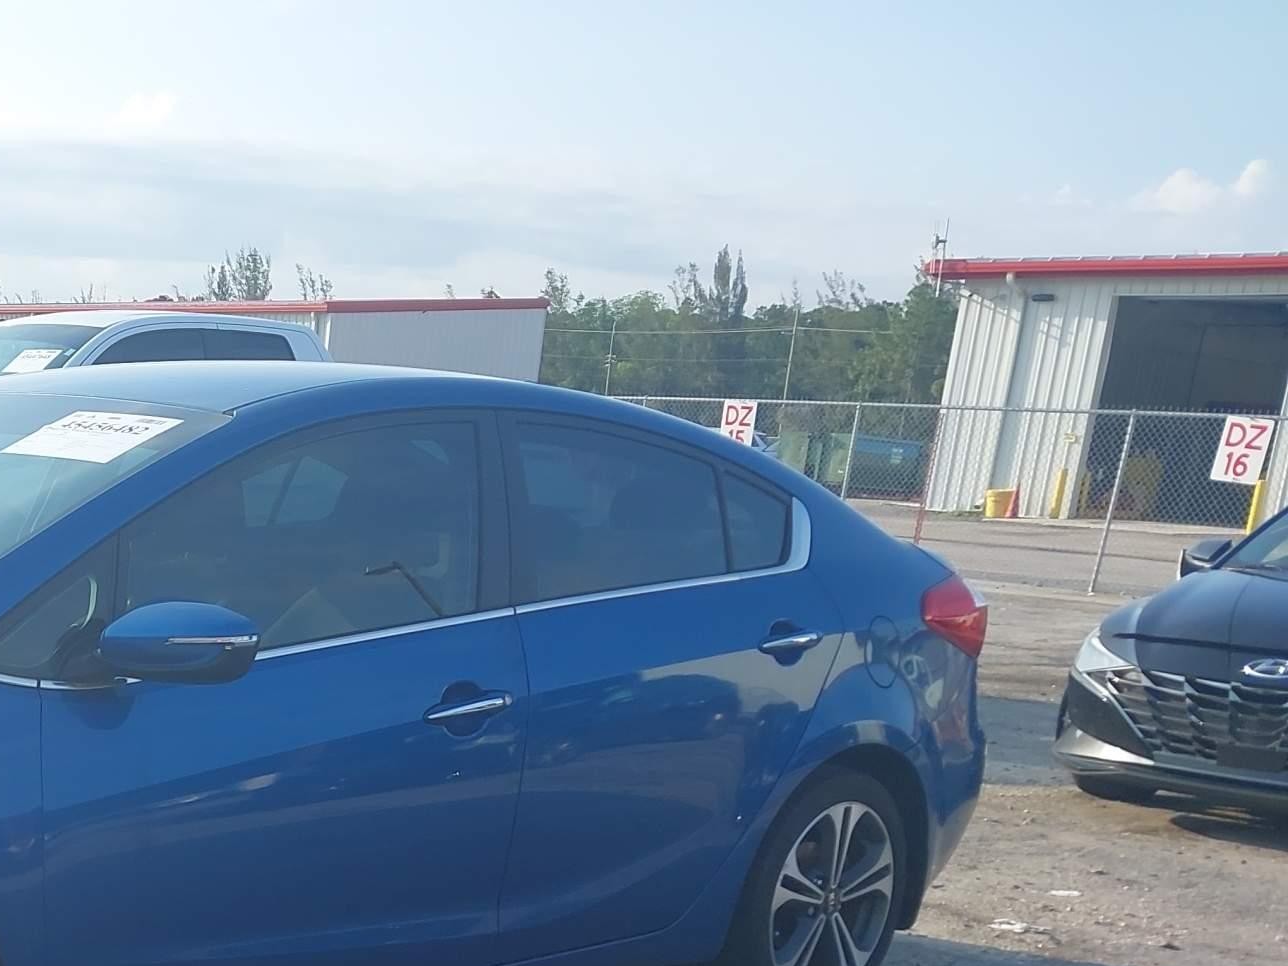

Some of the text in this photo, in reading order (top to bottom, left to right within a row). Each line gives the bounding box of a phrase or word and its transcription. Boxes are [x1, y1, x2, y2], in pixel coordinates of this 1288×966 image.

[725, 405, 753, 427] DZ
[1224, 421, 1268, 450] DZ
[1223, 451, 1250, 477] 16
